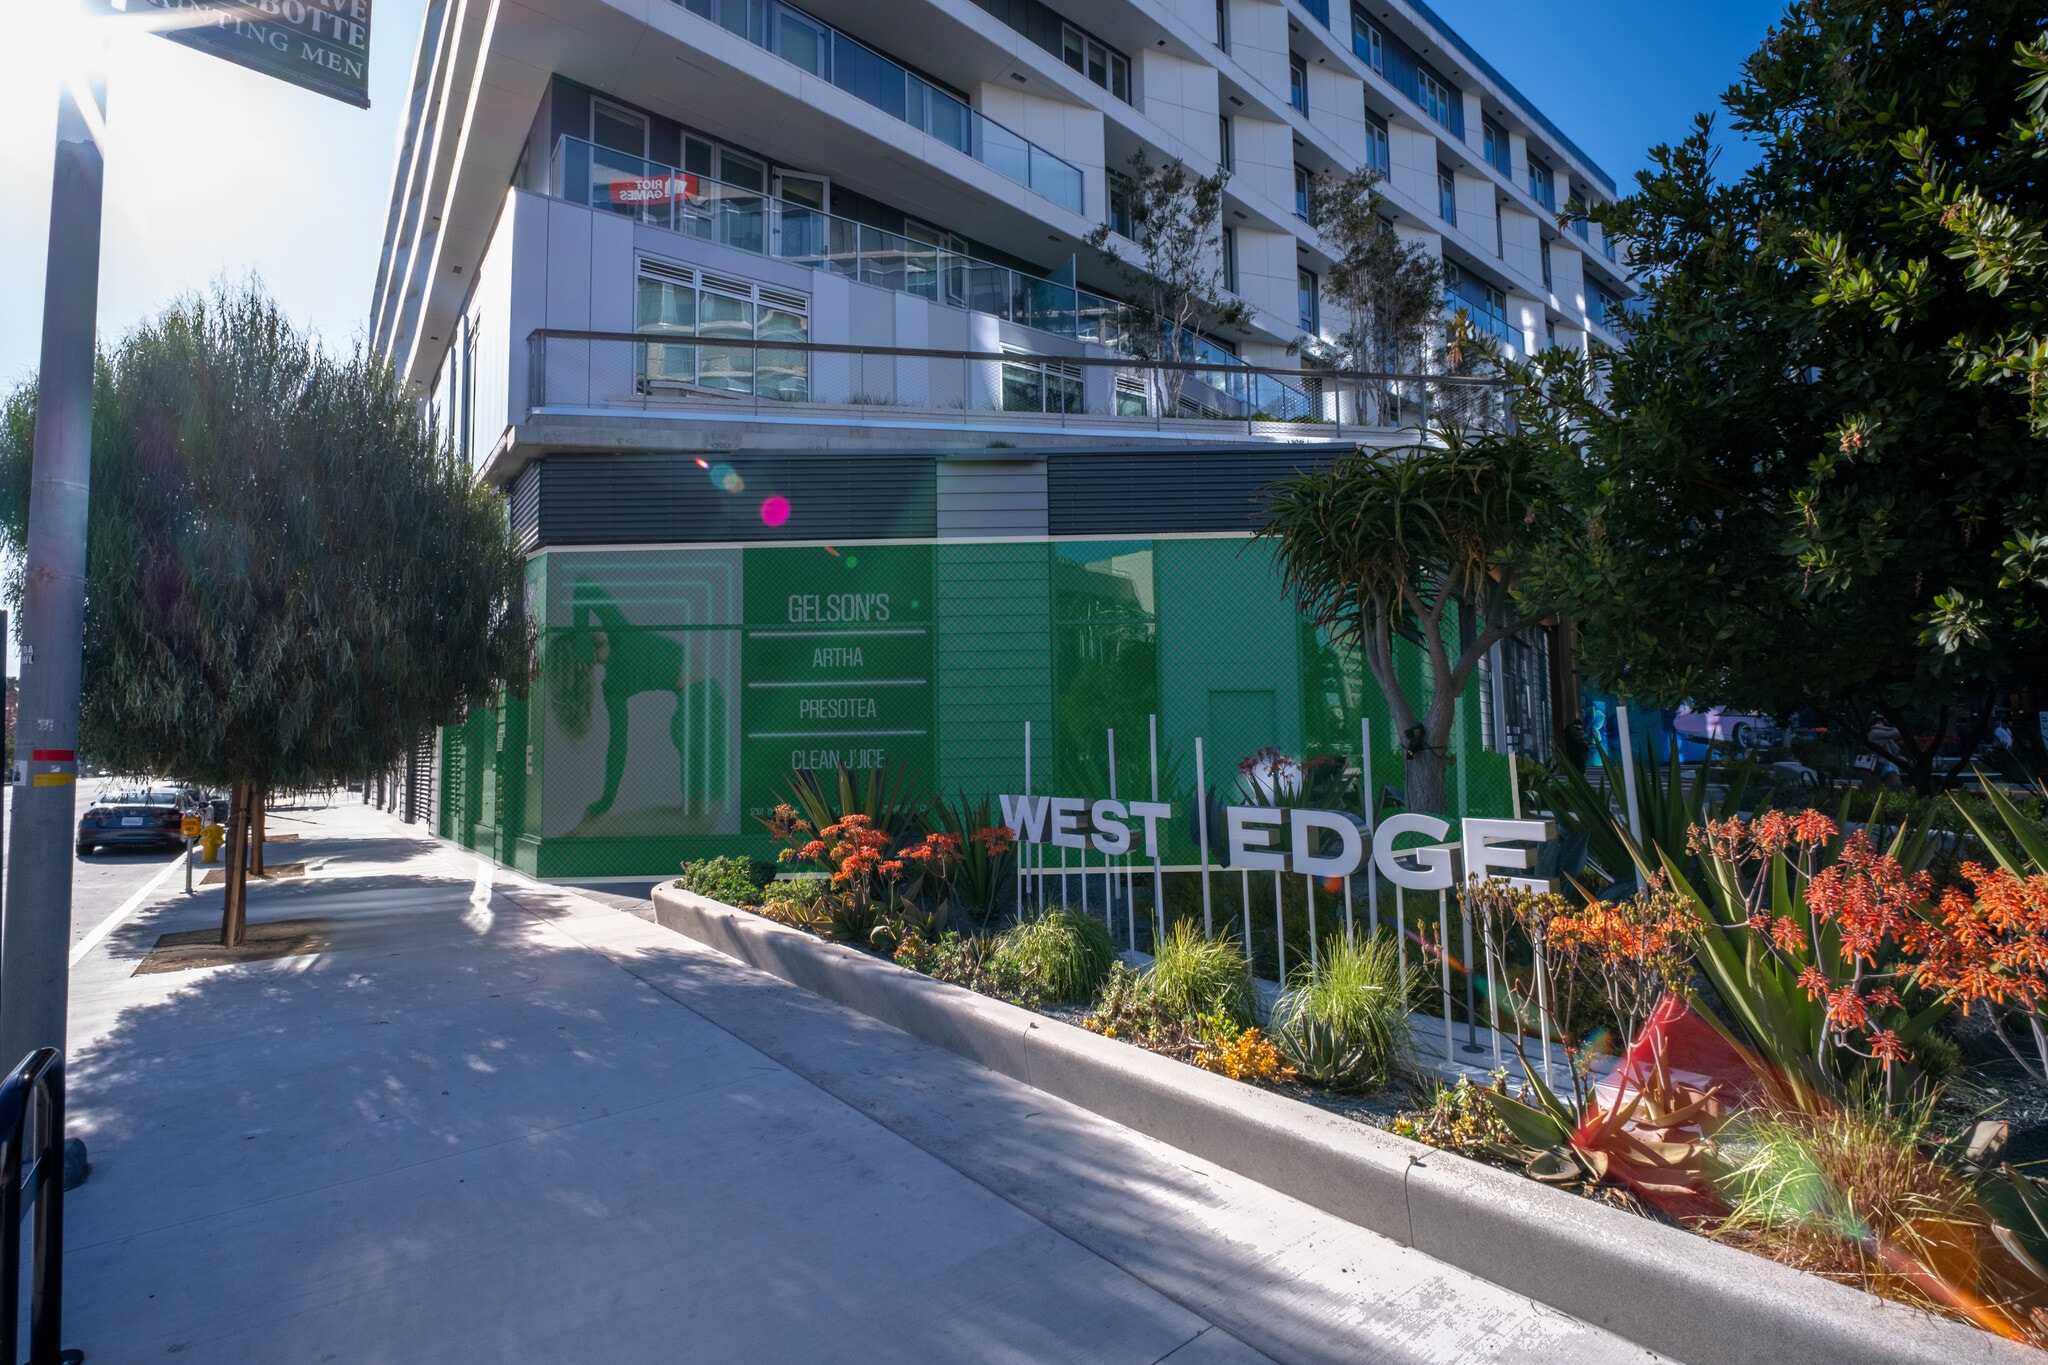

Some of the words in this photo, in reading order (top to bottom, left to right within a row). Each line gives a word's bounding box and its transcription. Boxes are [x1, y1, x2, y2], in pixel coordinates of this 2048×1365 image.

[300, 42, 363, 79] MEN
[788, 593, 890, 623] GELSON'S
[812, 648, 863, 667] ARTHA
[800, 698, 877, 718] PRESOTEA
[792, 750, 839, 769] CLEAN
[999, 794, 1171, 858] WEST
[1227, 806, 1556, 893] EDGE
